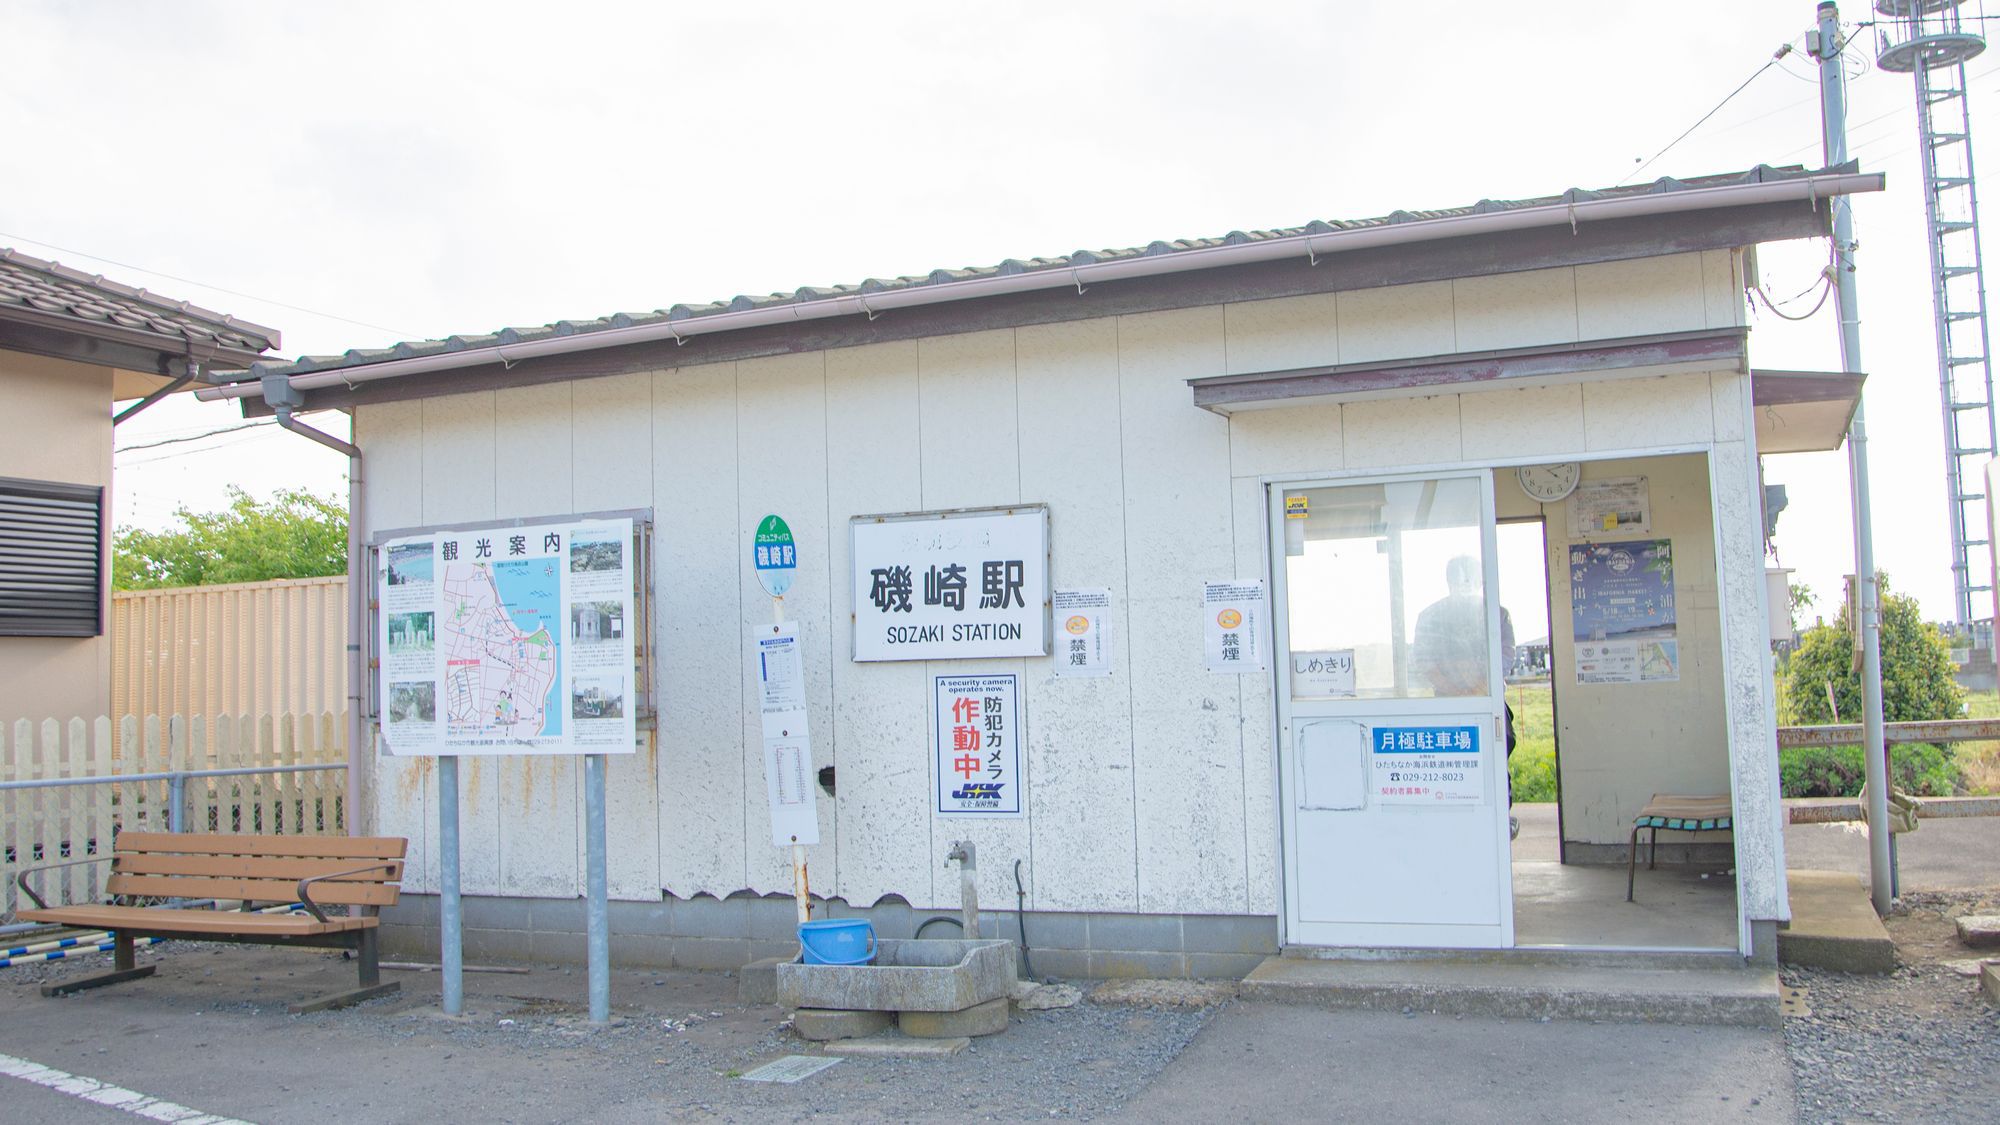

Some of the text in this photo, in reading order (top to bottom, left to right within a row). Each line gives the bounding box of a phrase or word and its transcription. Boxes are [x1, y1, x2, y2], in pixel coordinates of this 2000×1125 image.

[442, 532, 561, 561] 観光案内
[757, 533, 790, 543] コミュニティバス
[757, 545, 795, 566] 磯崎駅
[869, 560, 1026, 613] 磯崎駅
[887, 623, 1021, 644] SOZAKI STATION
[1070, 638, 1087, 666] 禁煙
[1222, 633, 1240, 661] 禁煙
[1294, 656, 1351, 674] しめきり
[948, 679, 980, 687] security
[952, 697, 981, 780] 作動中
[984, 696, 1004, 780] 防犯カメラ
[1381, 731, 1471, 750] 月極駐車場
[1402, 773, 1464, 782] 029-212-8023
[1381, 787, 1430, 795] 契約者募集中
